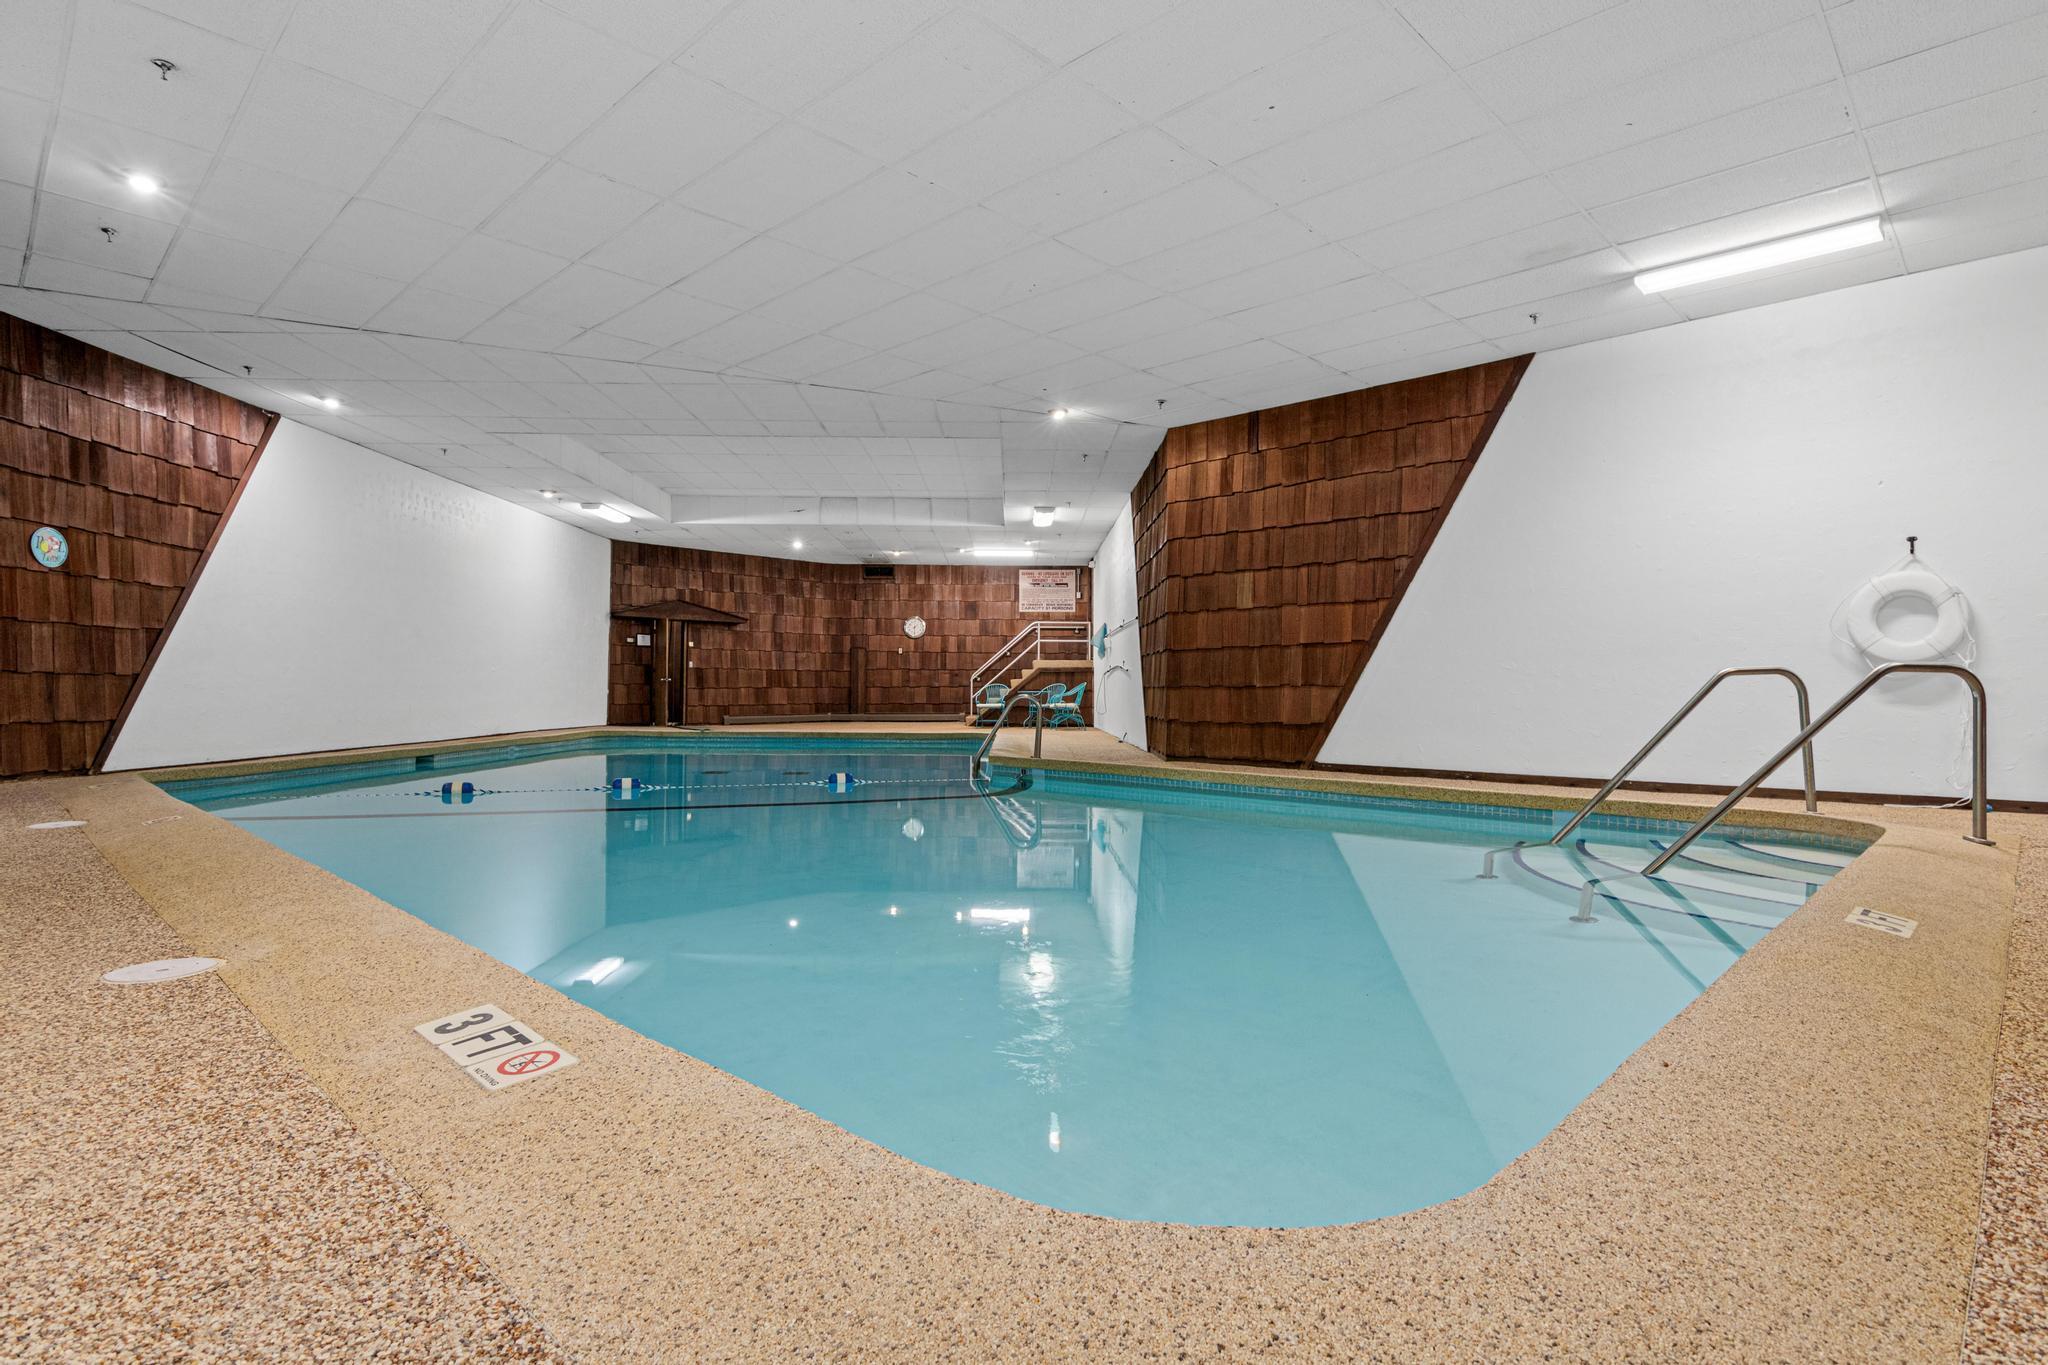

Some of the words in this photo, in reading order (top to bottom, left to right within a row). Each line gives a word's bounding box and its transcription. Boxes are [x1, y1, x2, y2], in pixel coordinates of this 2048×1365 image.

[1860, 908, 1909, 927] FT
[434, 1013, 493, 1035] 3
[451, 1025, 533, 1059] FT
